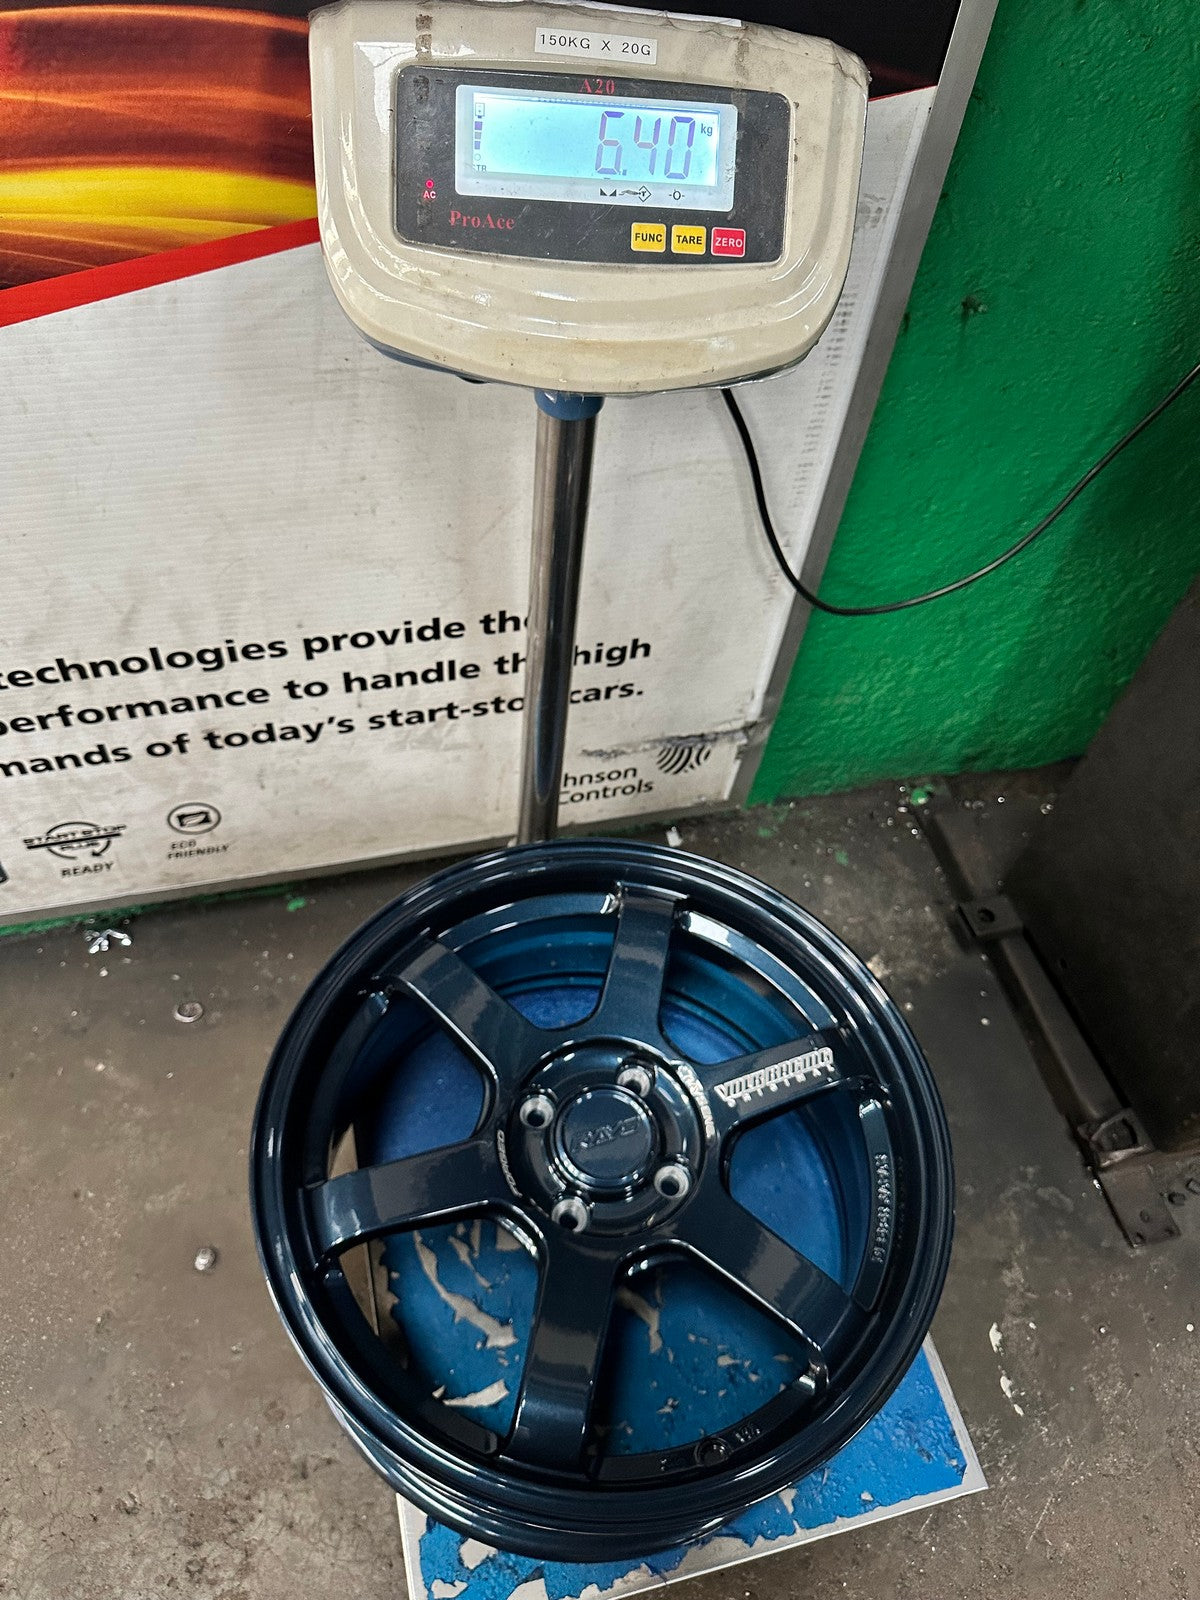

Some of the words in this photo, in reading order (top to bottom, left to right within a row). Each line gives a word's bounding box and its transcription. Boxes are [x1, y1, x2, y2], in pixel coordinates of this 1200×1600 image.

[539, 33, 592, 52] 150KG
[600, 39, 612, 52] X
[620, 40, 653, 57] 20G
[579, 79, 616, 96] A20
[594, 110, 696, 180] 6.40
[700, 123, 714, 137] kg
[423, 189, 437, 200] AC
[449, 209, 515, 231] ProAce
[634, 231, 663, 245] FUNC
[675, 234, 703, 247] TARE
[715, 237, 744, 249] ZERO
[303, 617, 465, 660] provide
[284, 679, 329, 700] to
[344, 659, 480, 694] handle
[494, 652, 526, 675] th
[573, 638, 651, 667] high
[0, 744, 131, 777] mands
[146, 733, 191, 758] of
[203, 715, 355, 750] today's
[368, 695, 524, 731] start-sto
[569, 682, 644, 704] cars.
[563, 767, 637, 788] hnson
[167, 844, 229, 859] FRIENDLY
[61, 861, 114, 877] READY
